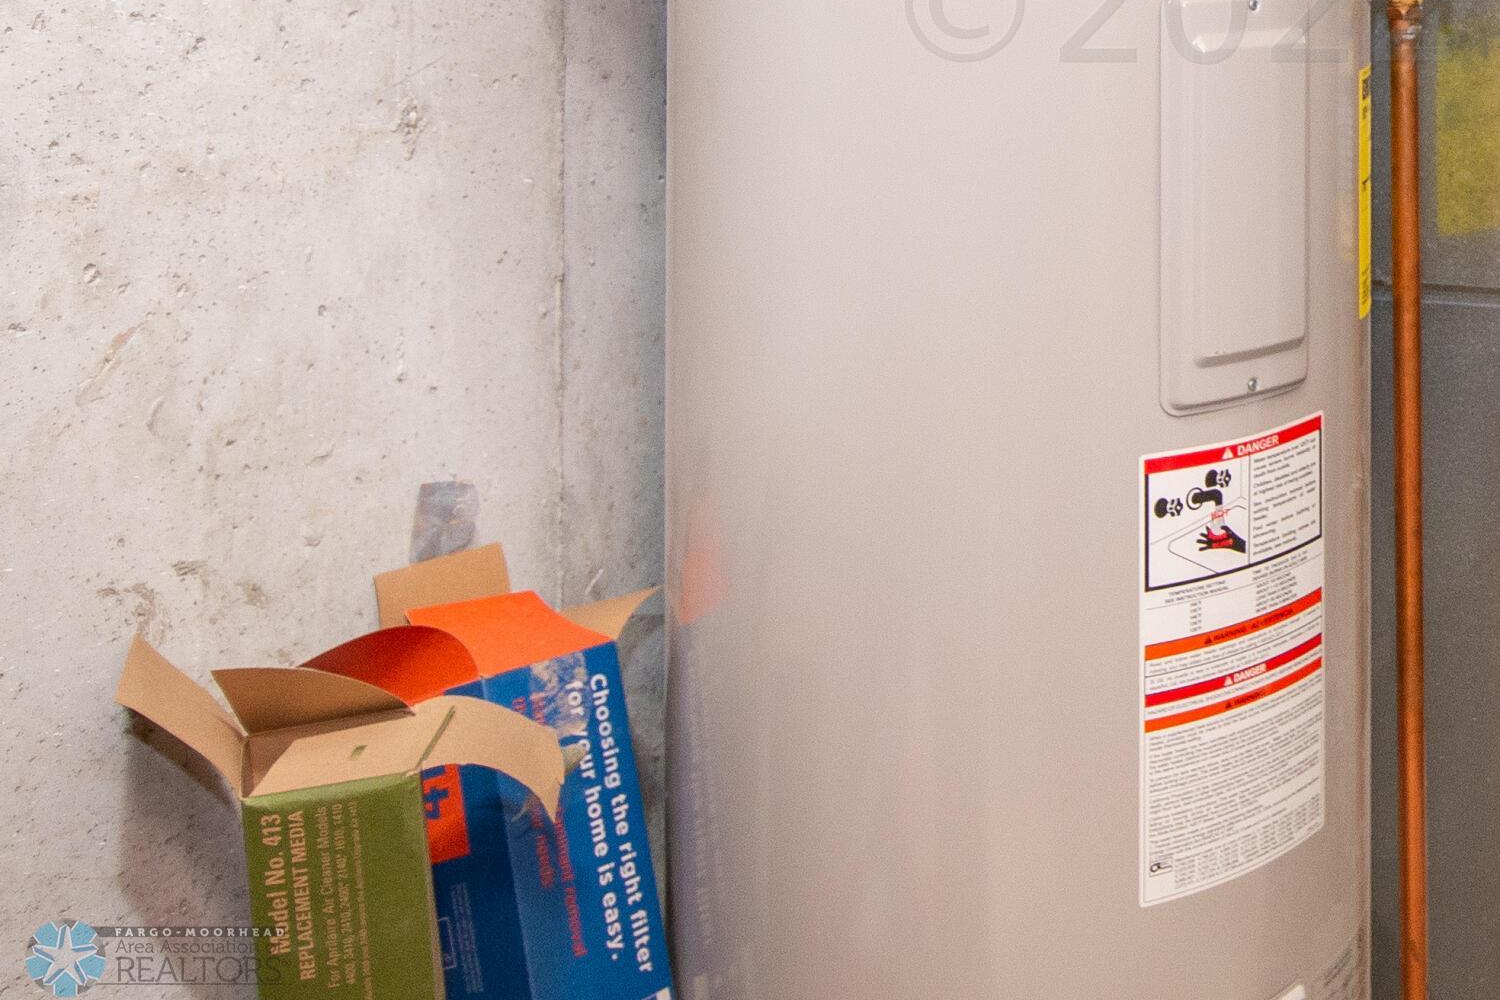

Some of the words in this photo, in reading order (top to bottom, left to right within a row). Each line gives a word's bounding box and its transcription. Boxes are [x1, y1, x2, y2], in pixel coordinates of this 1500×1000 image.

[1237, 434, 1279, 456] DANGER
[1233, 663, 1267, 683] DANGER
[566, 680, 584, 716] for
[590, 673, 621, 788] Choosing
[260, 814, 282, 846] 413
[315, 806, 330, 849] Models
[584, 785, 609, 857] home
[611, 794, 629, 835] the
[288, 811, 307, 862] MEDIA
[265, 851, 286, 886] No.
[320, 852, 334, 895] Cleaner
[597, 861, 615, 886] is
[619, 842, 643, 905] right
[266, 890, 291, 955] Model
[291, 868, 316, 980] REPLACEMENT
[602, 892, 625, 961] easy.
[630, 910, 653, 972] filter
[328, 970, 340, 988] For
